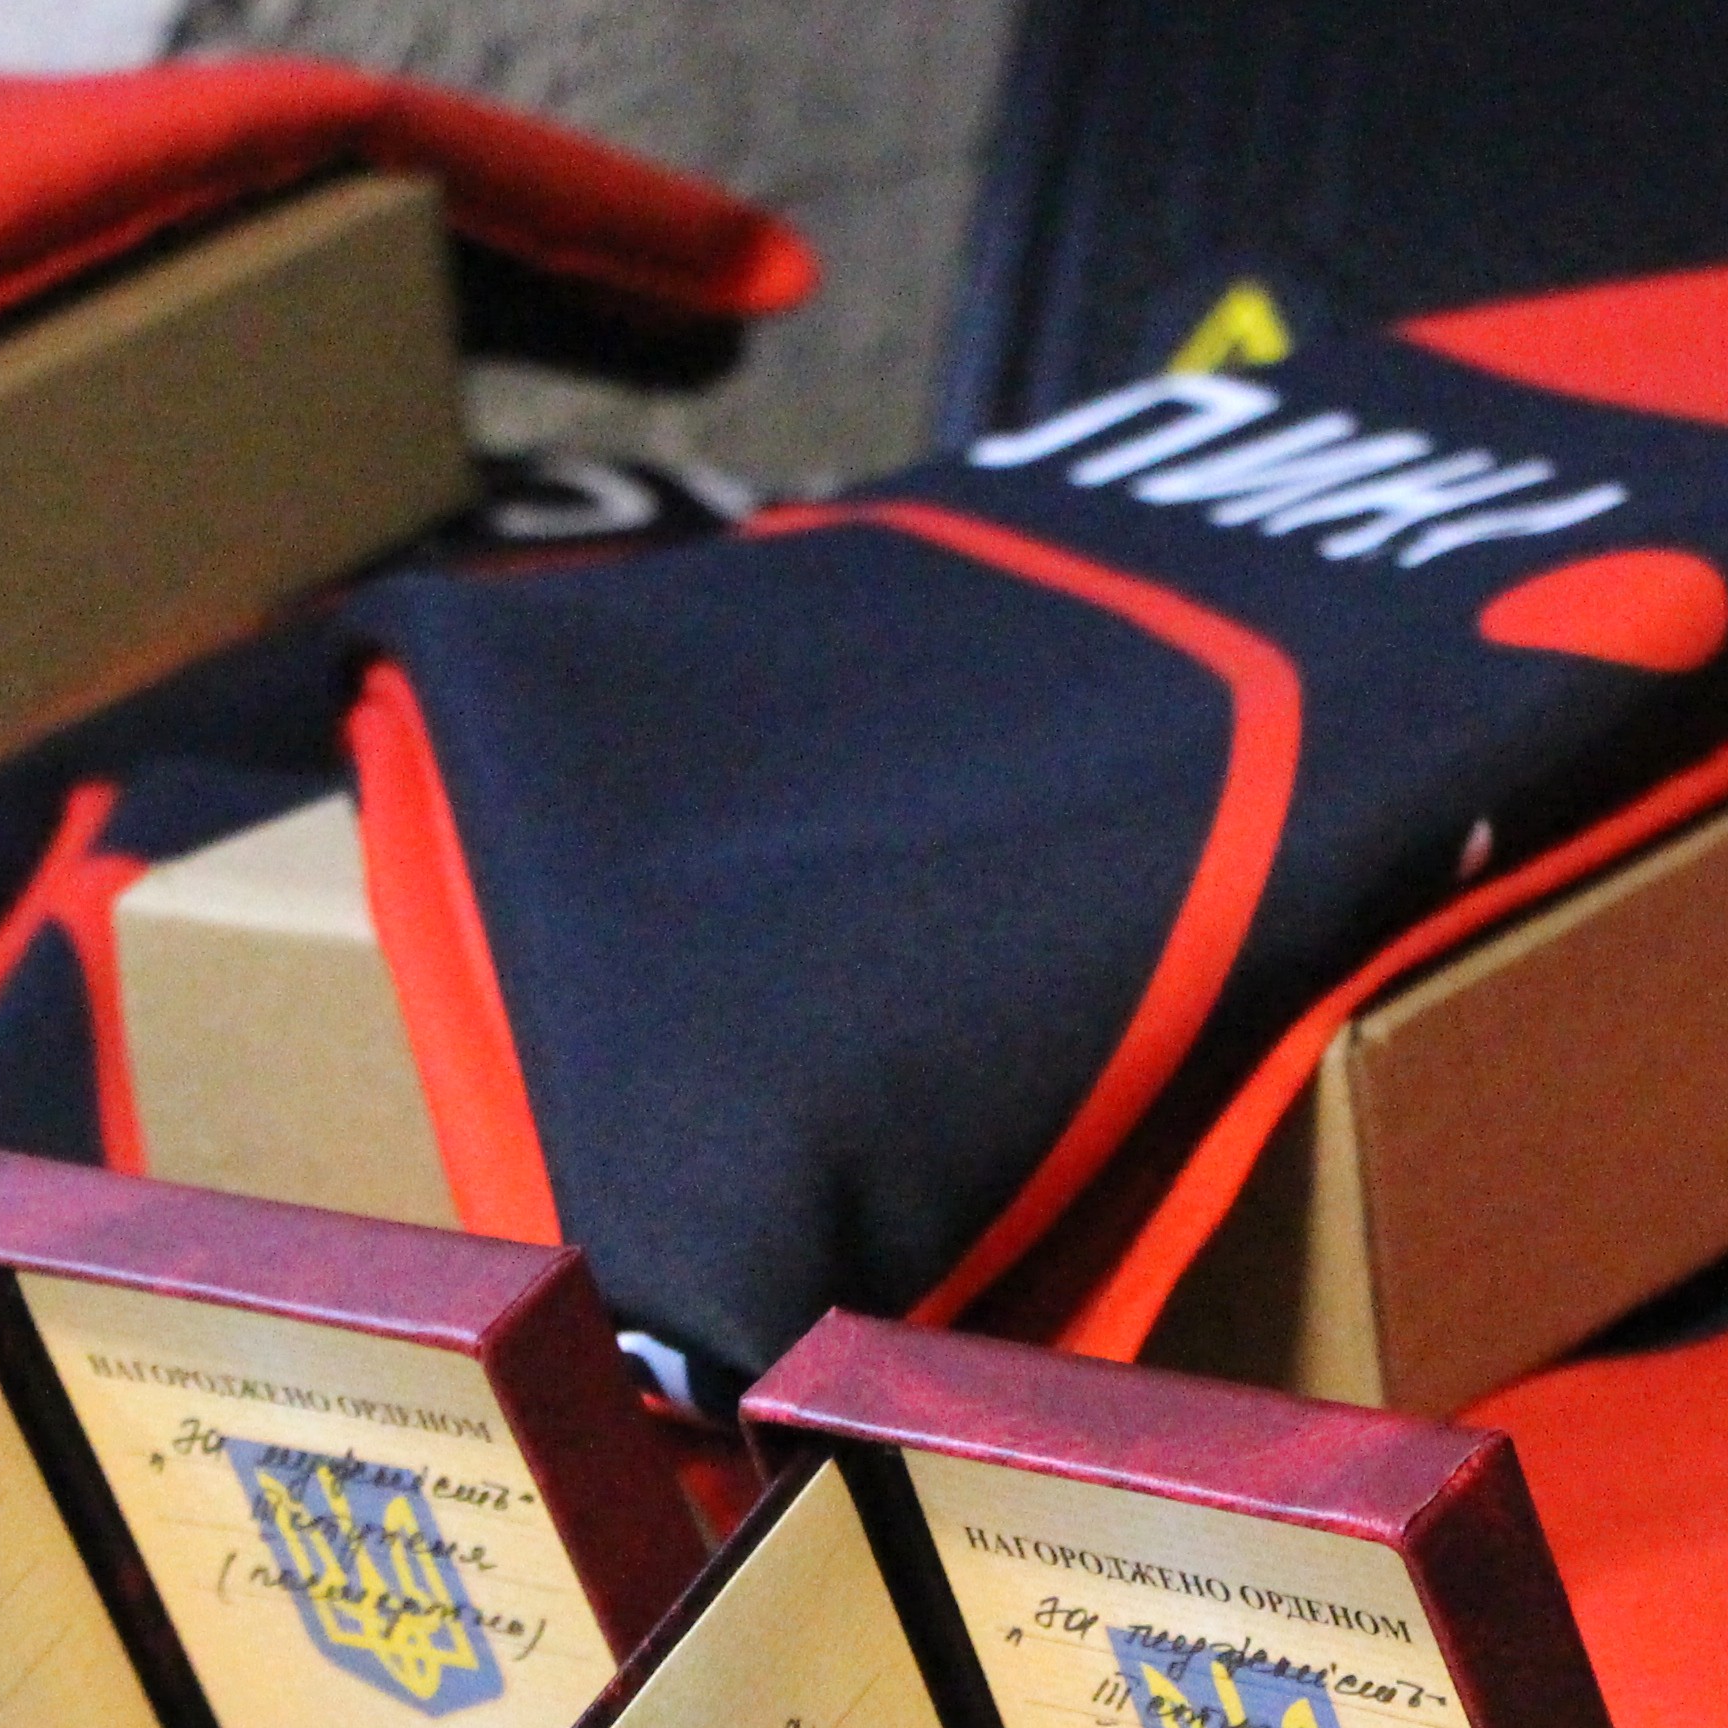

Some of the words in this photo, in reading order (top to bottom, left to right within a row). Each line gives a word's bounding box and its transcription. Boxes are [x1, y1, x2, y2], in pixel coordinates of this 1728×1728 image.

[86, 1352, 332, 1412] НАГОРОДЖЕНО
[964, 1525, 1233, 1602] НАГОРОДЖЕНО
[1239, 1584, 1414, 1644] ОРДЕНОМ
